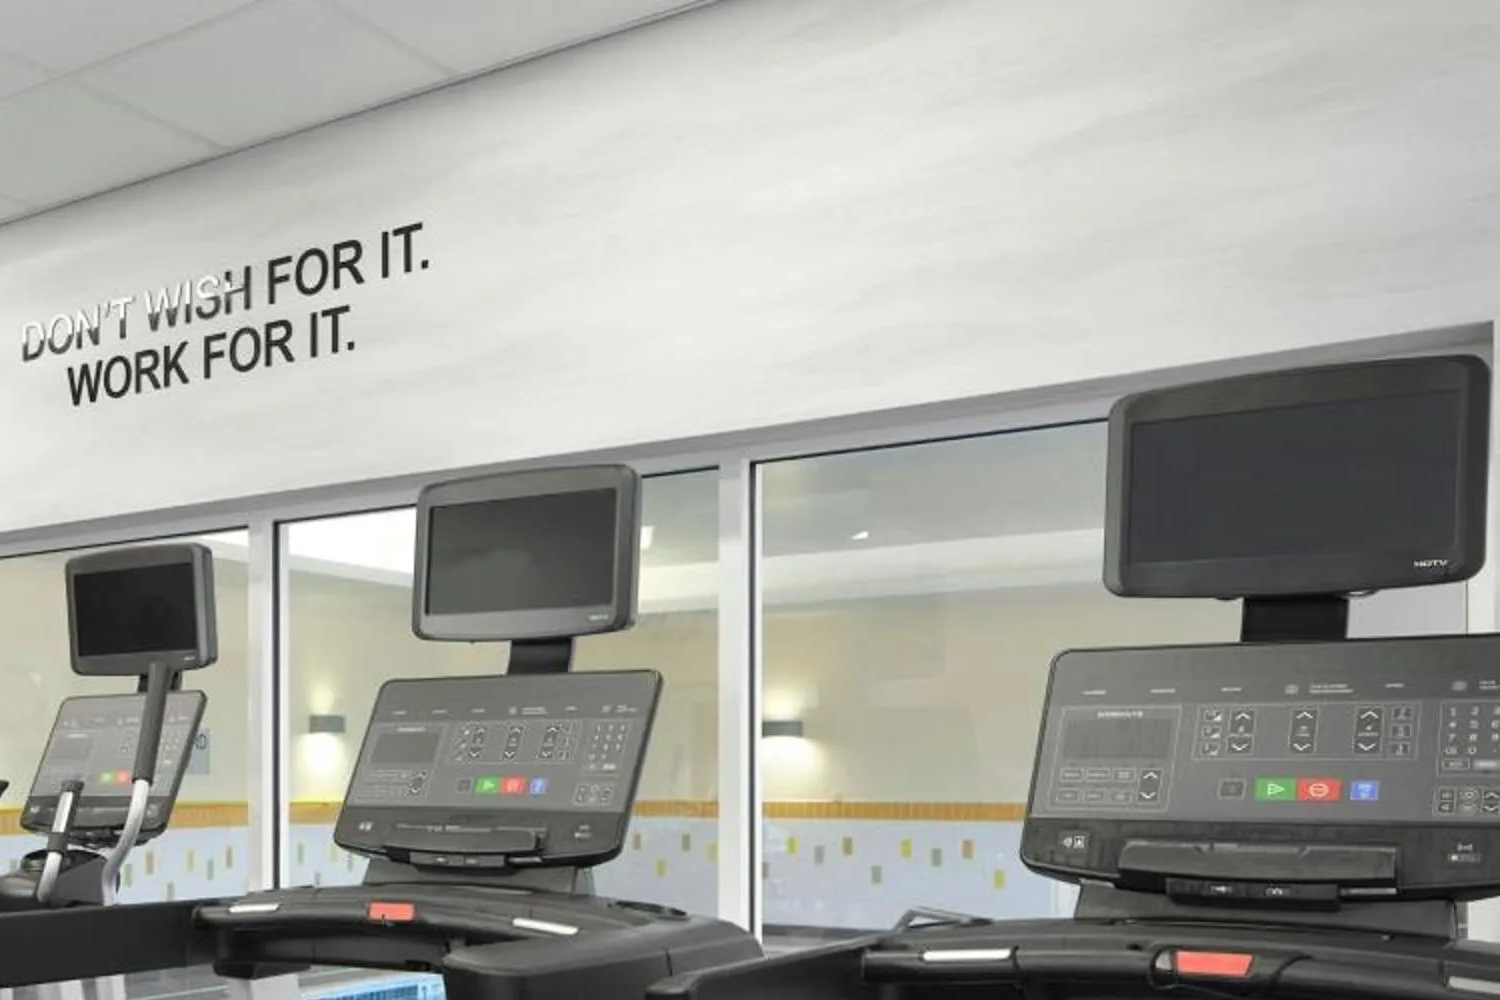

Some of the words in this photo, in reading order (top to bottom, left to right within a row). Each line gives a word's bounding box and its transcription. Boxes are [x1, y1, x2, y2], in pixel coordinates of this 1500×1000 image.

[21, 297, 135, 362] DON'T
[146, 265, 251, 332] WISH
[267, 239, 365, 304] FOR
[381, 222, 430, 279] IT.
[67, 341, 189, 406] WORK
[203, 319, 294, 379] FOR
[310, 305, 355, 357] IT.
